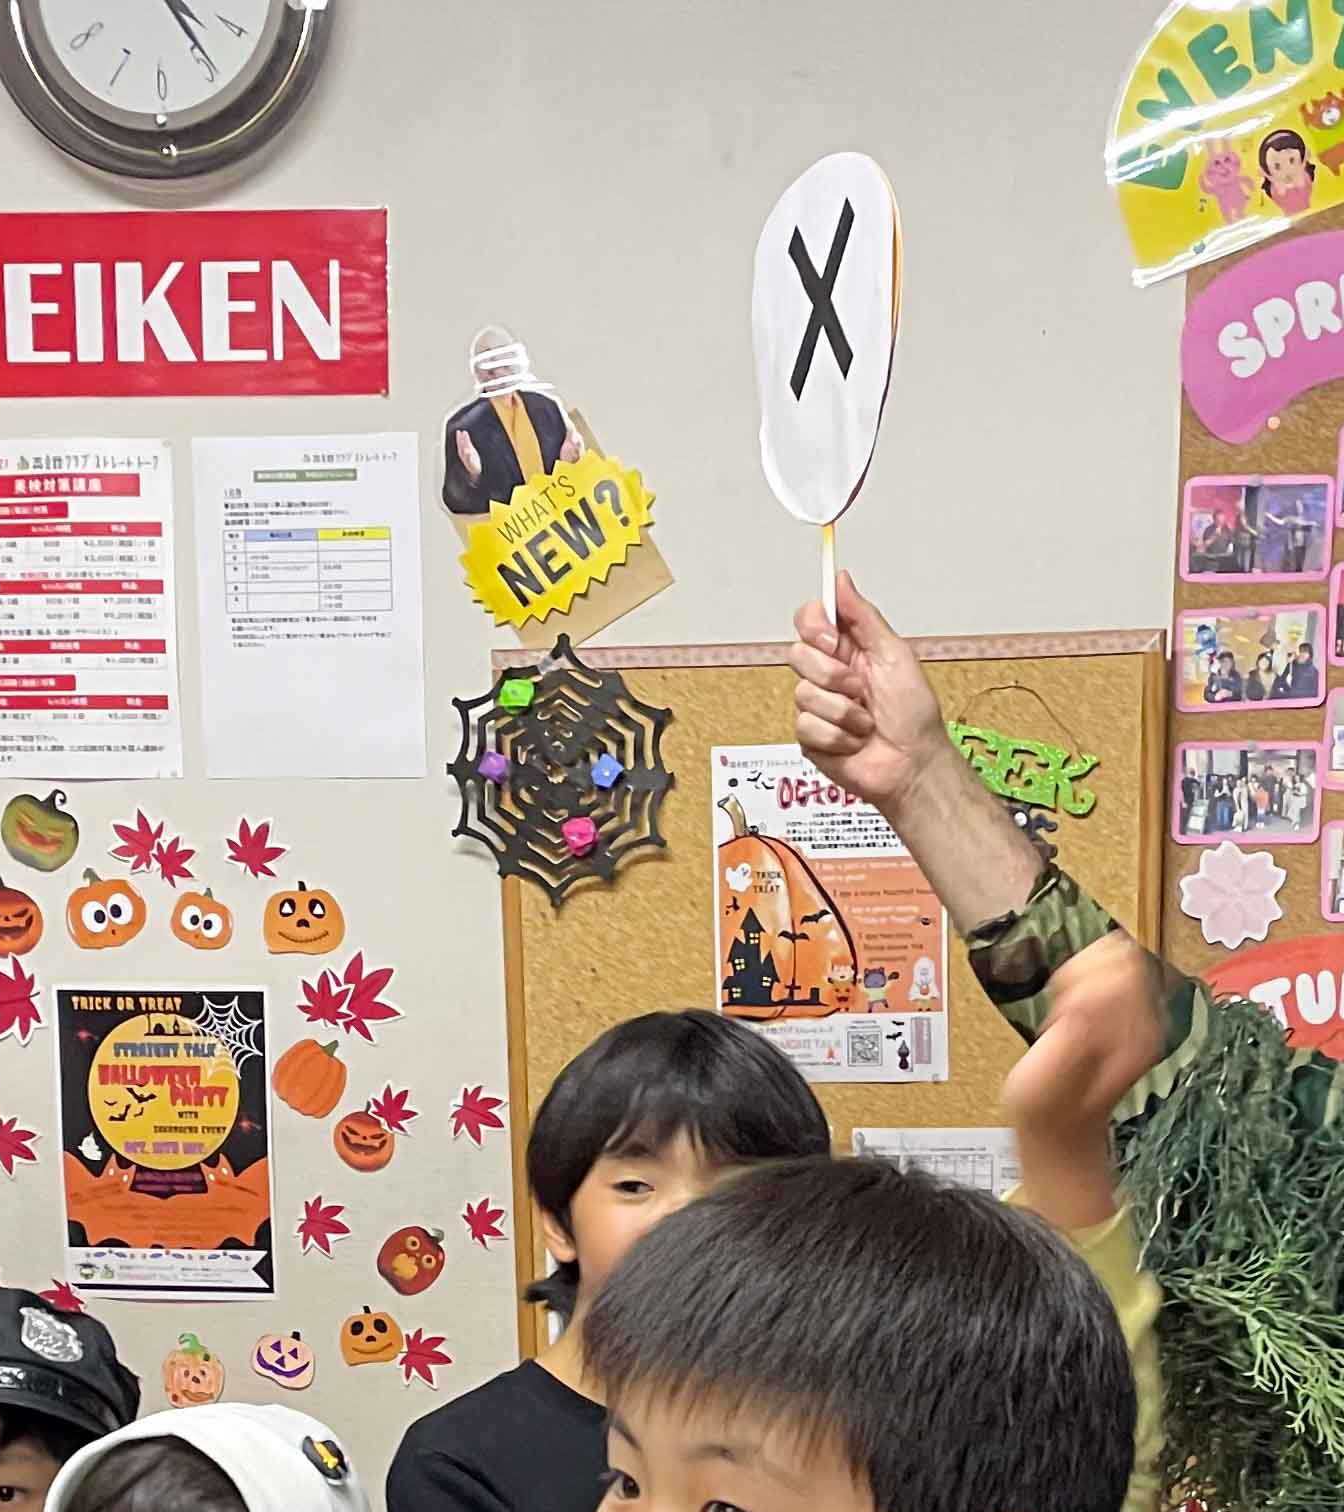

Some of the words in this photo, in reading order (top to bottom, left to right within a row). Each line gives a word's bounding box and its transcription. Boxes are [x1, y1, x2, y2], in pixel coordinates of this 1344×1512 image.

[3, 259, 341, 363] EIKEN
[497, 474, 576, 544] WHAT'S
[71, 996, 112, 1010] TRICK
[116, 997, 135, 1010] OR
[139, 997, 183, 1011] TREAT
[98, 1064, 201, 1087] HALLOWEEN
[170, 1086, 229, 1107] PARTY
